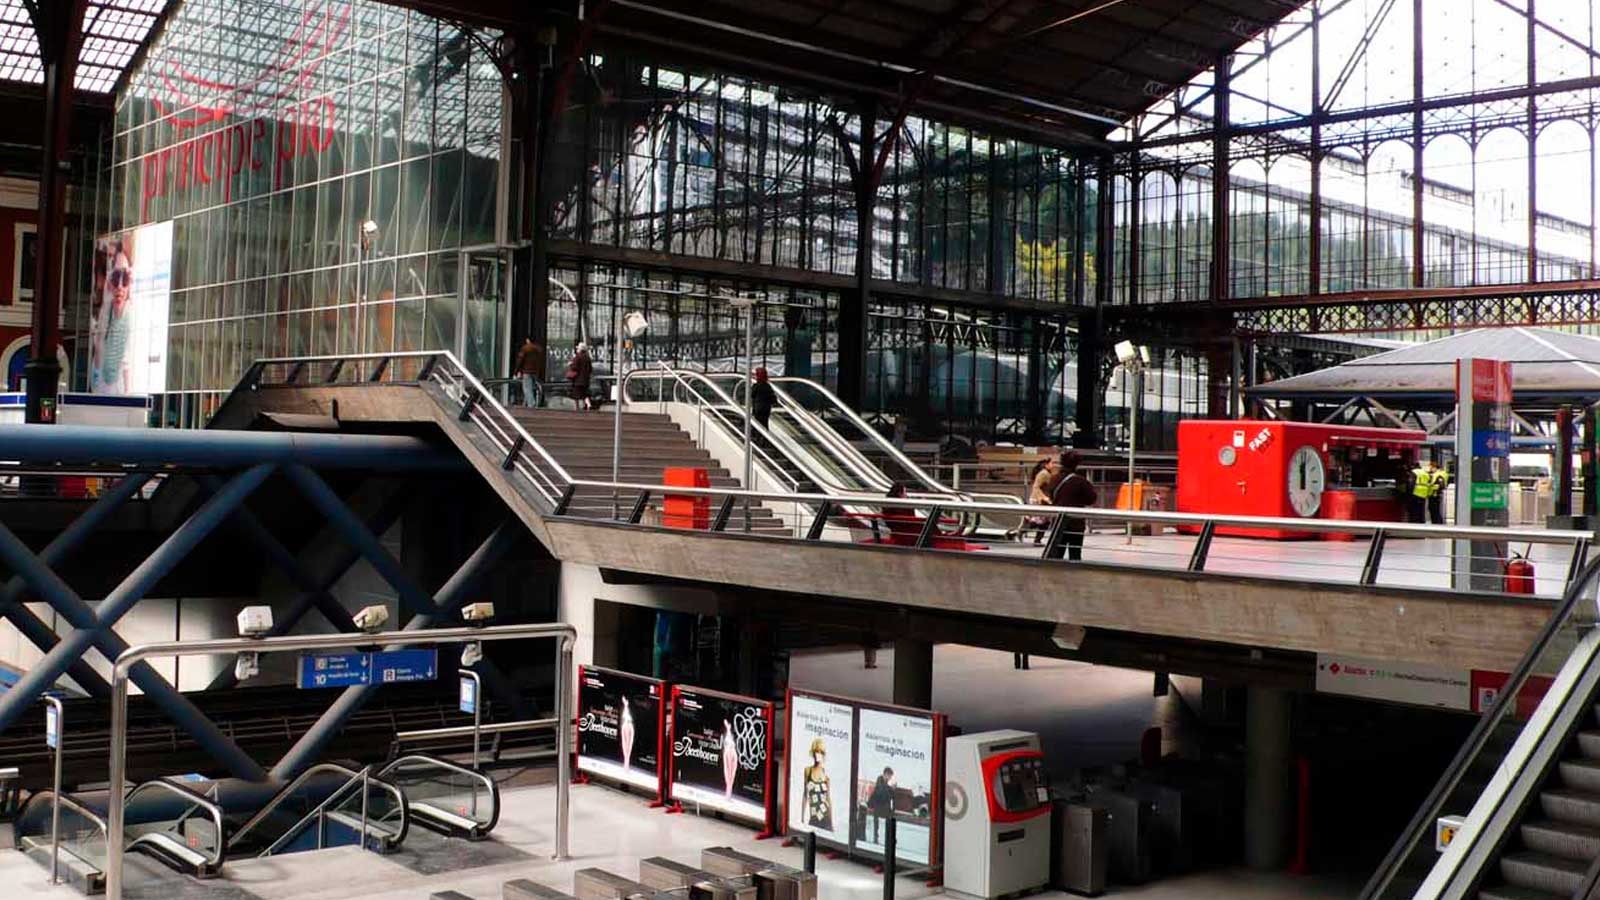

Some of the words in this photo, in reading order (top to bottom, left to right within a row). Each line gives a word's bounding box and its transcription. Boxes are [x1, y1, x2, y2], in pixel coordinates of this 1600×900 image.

[1248, 427, 1272, 452] FAST
[314, 673, 327, 686] 10
[578, 712, 618, 737] Beethoven
[672, 735, 719, 762] Beethoven
